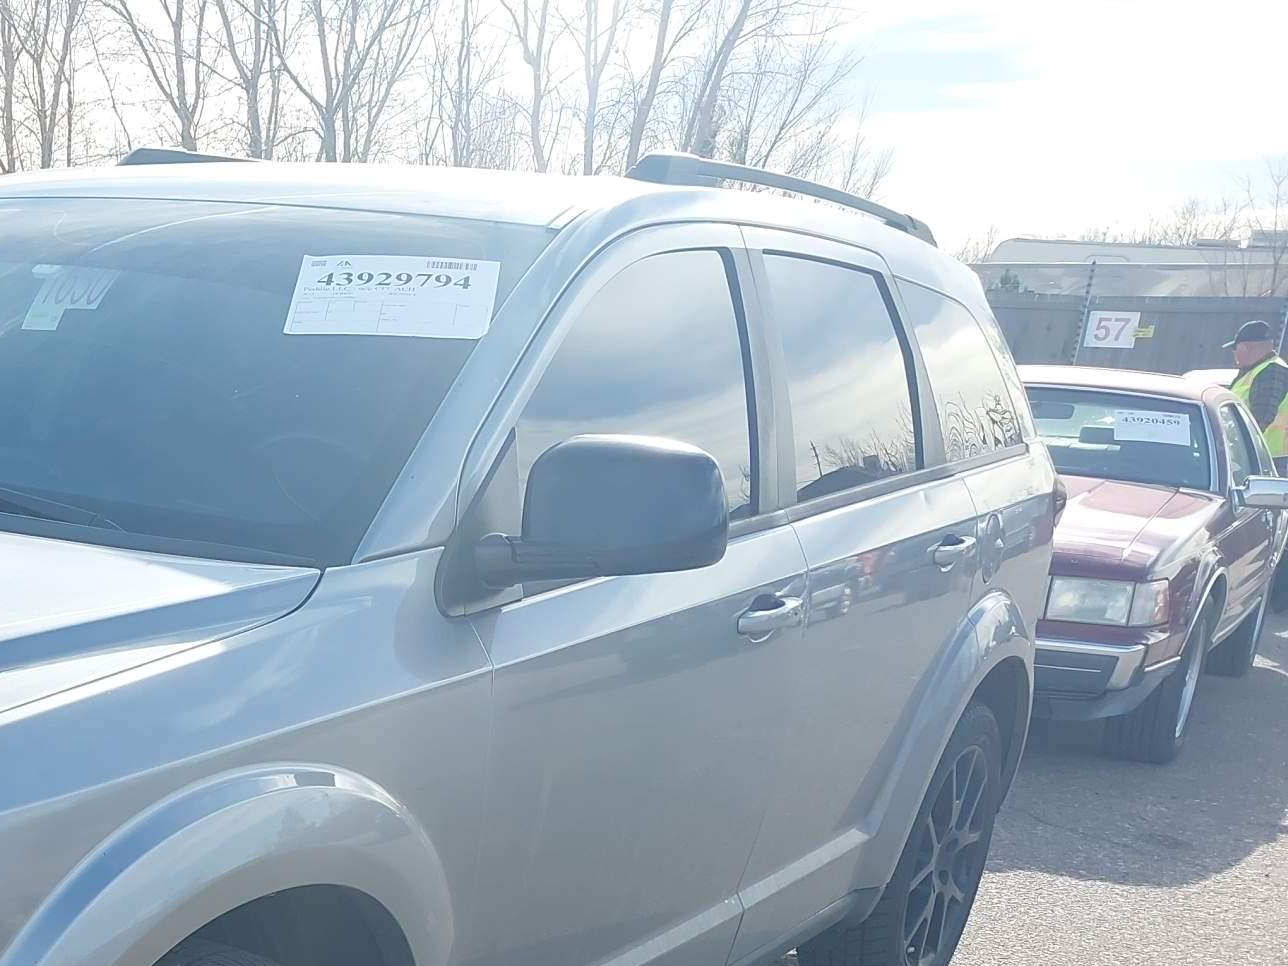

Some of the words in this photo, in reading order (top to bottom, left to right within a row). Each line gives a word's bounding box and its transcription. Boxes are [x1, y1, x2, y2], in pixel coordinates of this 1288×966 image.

[317, 271, 472, 290] 43929794
[1094, 317, 1131, 341] 57
[1121, 416, 1181, 426] 43920459
